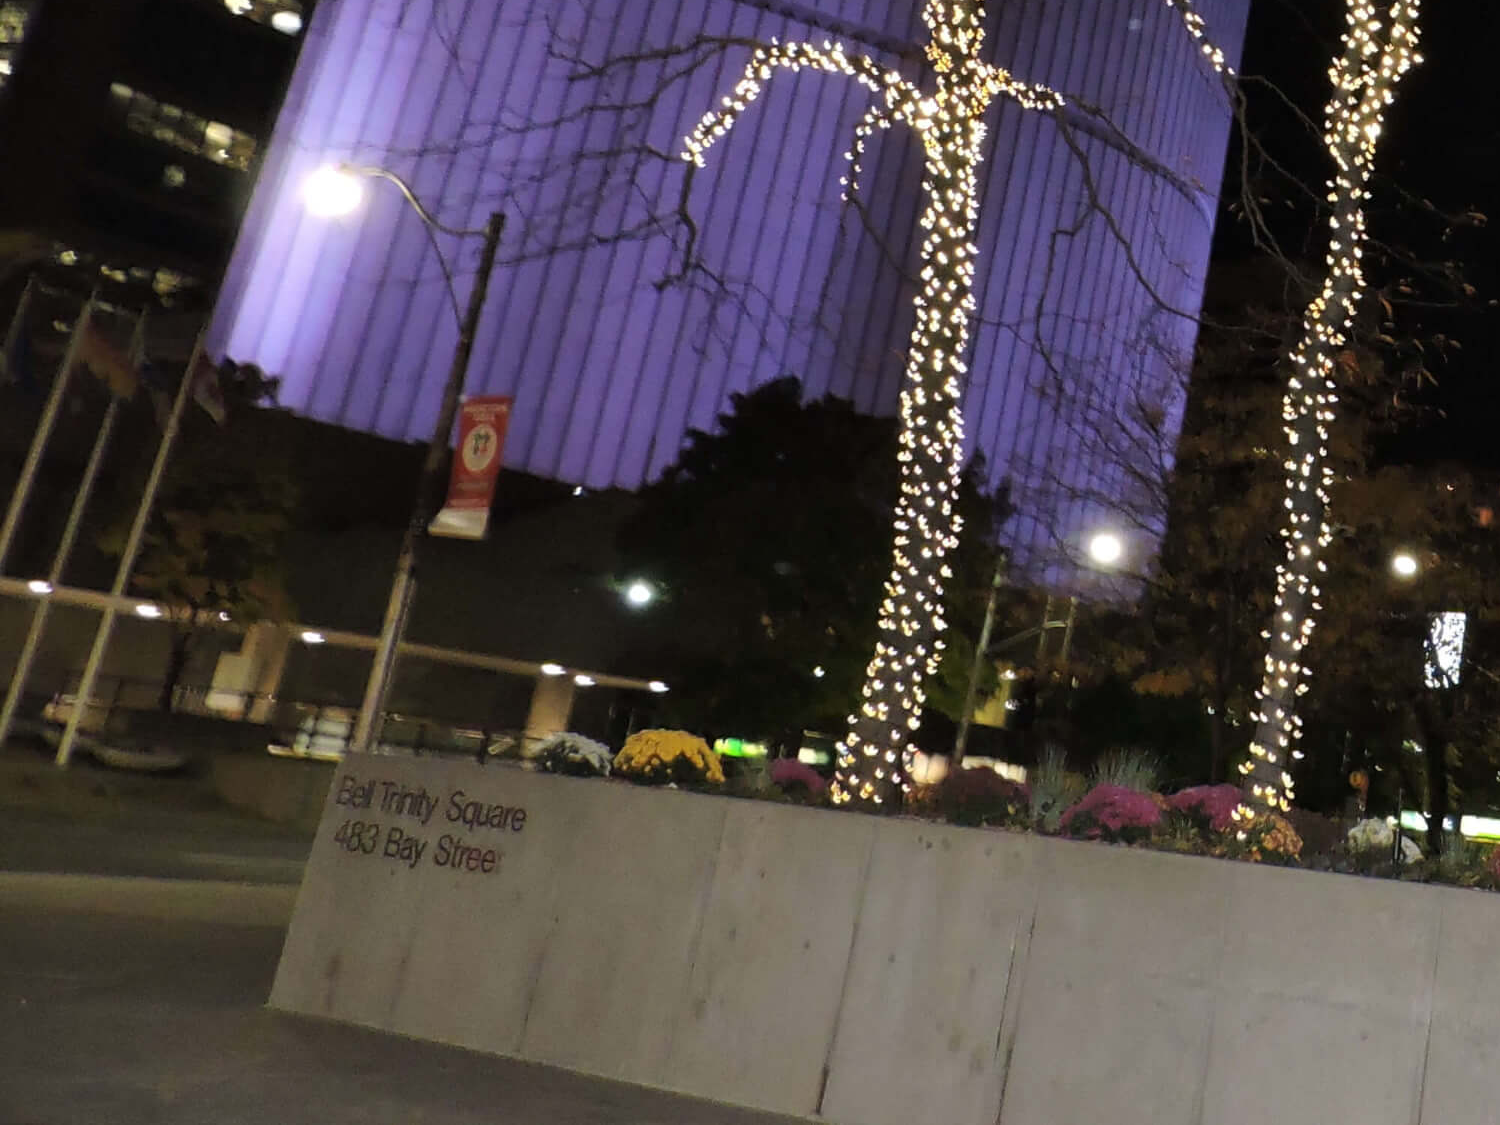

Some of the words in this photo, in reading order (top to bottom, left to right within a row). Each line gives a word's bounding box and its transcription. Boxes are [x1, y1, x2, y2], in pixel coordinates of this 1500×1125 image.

[336, 775, 376, 809] Bell
[380, 781, 438, 824] Trinity
[446, 790, 528, 832] Square
[334, 819, 379, 854] 483
[384, 826, 427, 868] Bay
